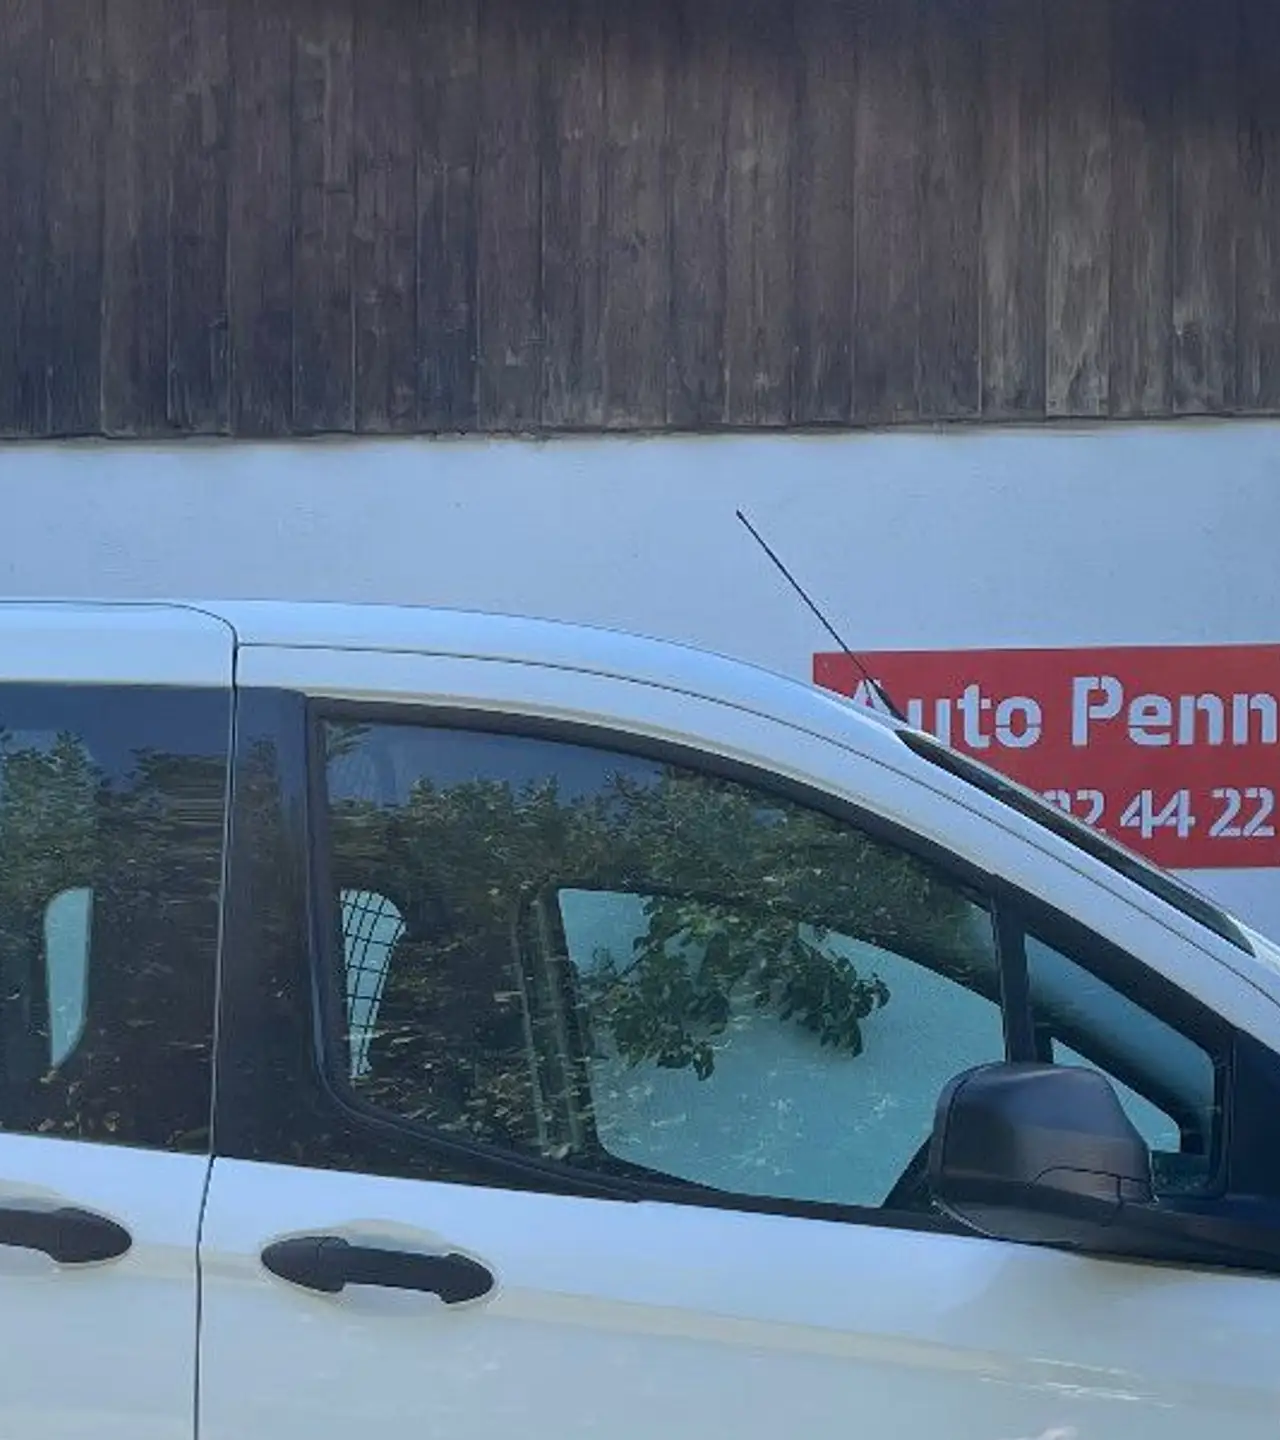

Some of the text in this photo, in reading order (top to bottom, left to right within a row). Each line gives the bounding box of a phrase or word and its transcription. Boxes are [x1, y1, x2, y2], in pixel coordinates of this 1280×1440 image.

[1072, 676, 1277, 745] Penn
[1120, 788, 1195, 838] 44
[1209, 787, 1274, 837] 22
